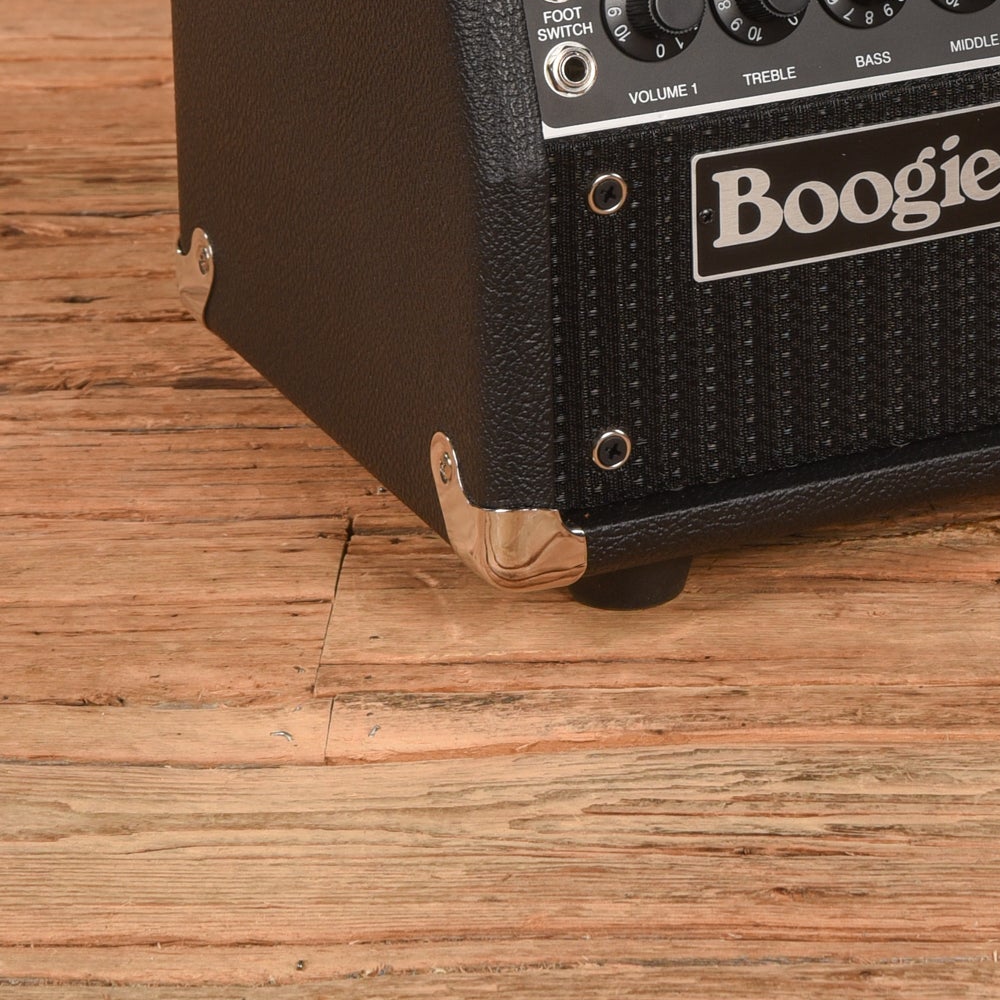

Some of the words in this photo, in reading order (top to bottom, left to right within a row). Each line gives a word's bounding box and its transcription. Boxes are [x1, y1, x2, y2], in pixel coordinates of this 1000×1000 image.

[543, 6, 582, 24] FOOT
[537, 22, 593, 42] SWITCH
[950, 33, 999, 53] MIDDLE
[855, 51, 892, 68] BASS
[743, 66, 797, 86] TREBLE
[629, 84, 688, 105] VOLUME
[691, 82, 698, 95] 1
